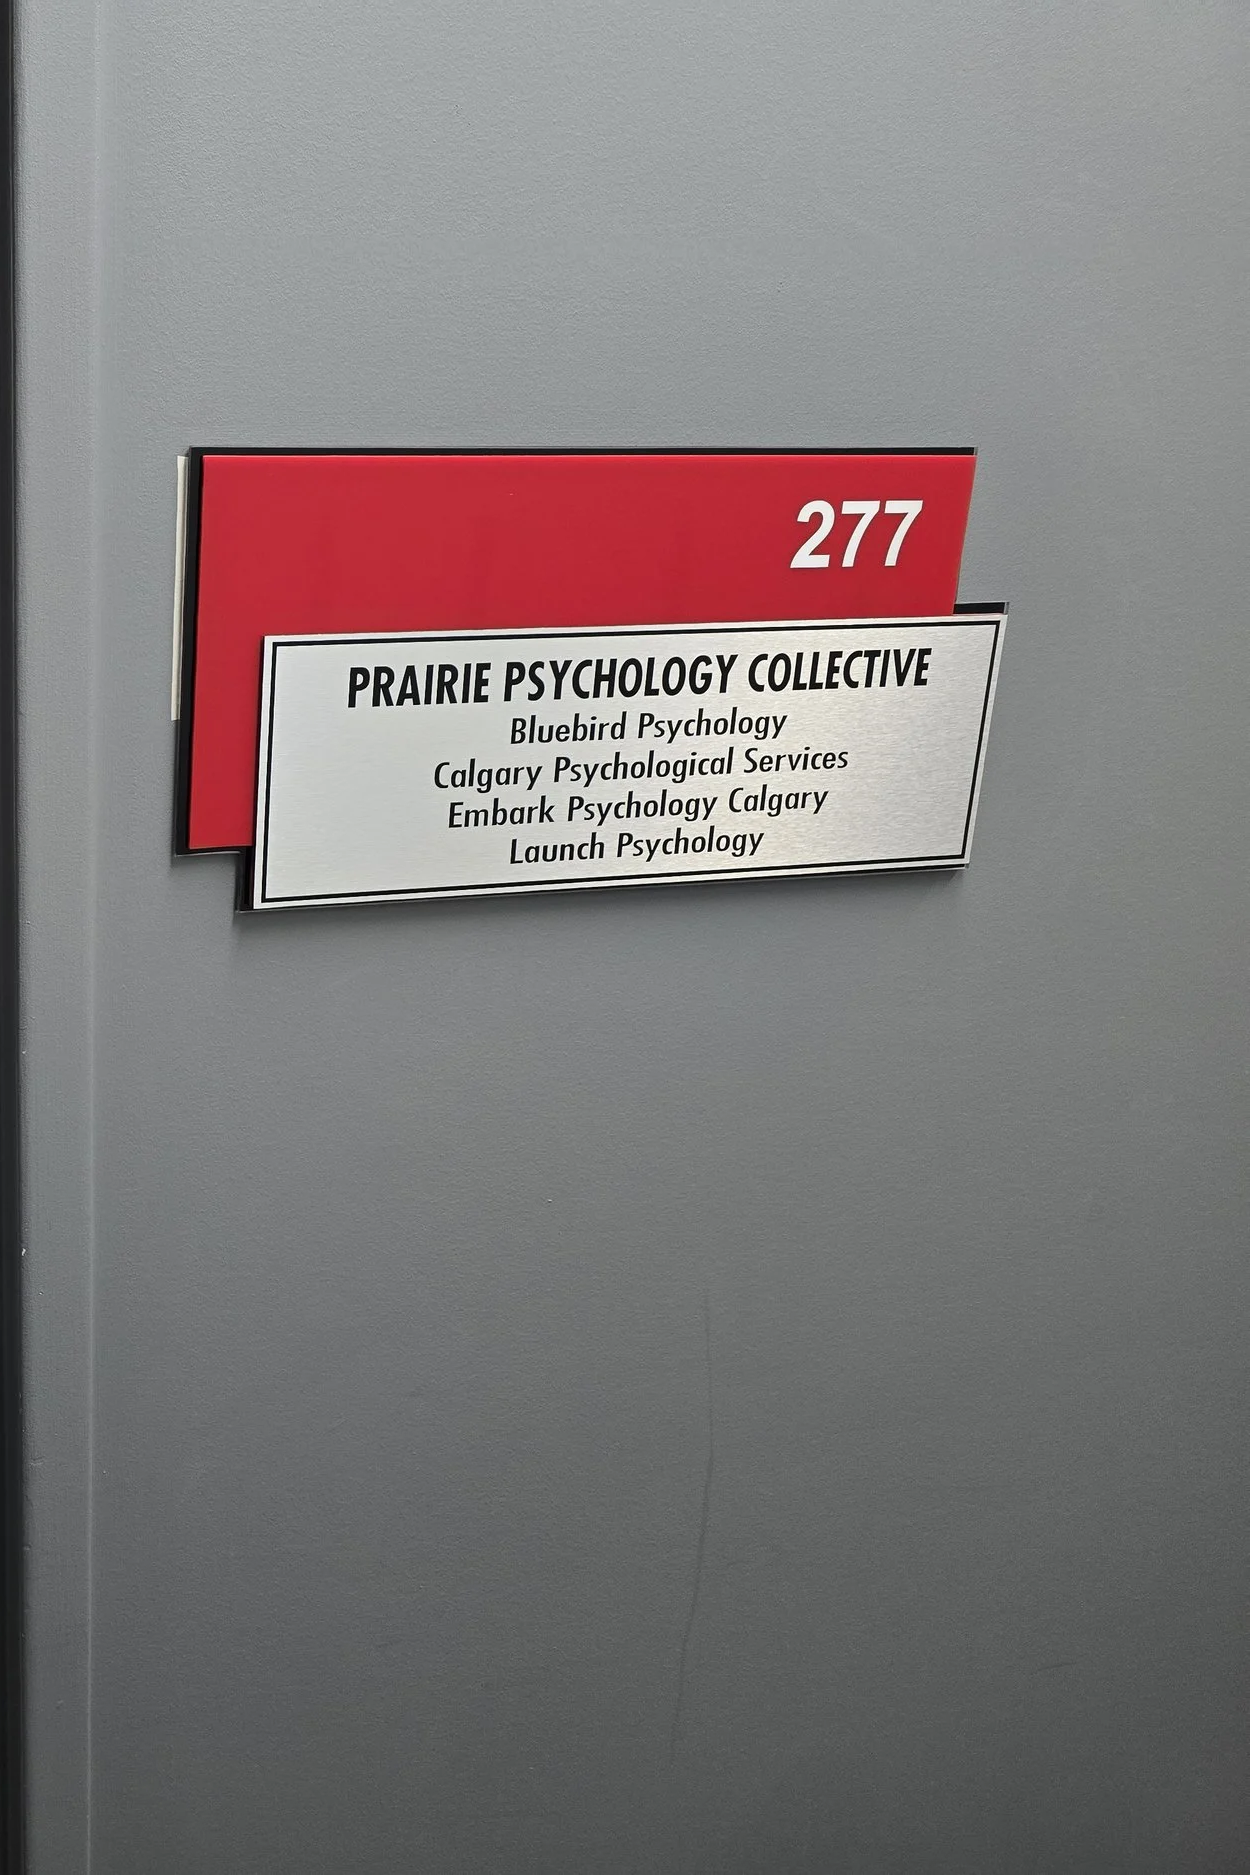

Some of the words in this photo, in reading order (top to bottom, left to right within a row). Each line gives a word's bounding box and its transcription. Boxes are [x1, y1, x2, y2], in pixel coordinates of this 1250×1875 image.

[790, 500, 923, 568] 277
[348, 663, 491, 708] PRAIRIE
[504, 653, 739, 702] PSYCHOLOGY
[748, 648, 932, 693] COLLECTIVE
[510, 715, 627, 745] Bluebird
[638, 711, 787, 742] Psychology
[435, 760, 543, 793] Calgary
[553, 752, 735, 786] Psychological
[744, 748, 849, 773] Services
[448, 798, 556, 828] Embark
[568, 792, 717, 823] Psychology
[727, 784, 829, 815] Calgary
[510, 834, 605, 865] Launch
[617, 827, 765, 859] Psychology
